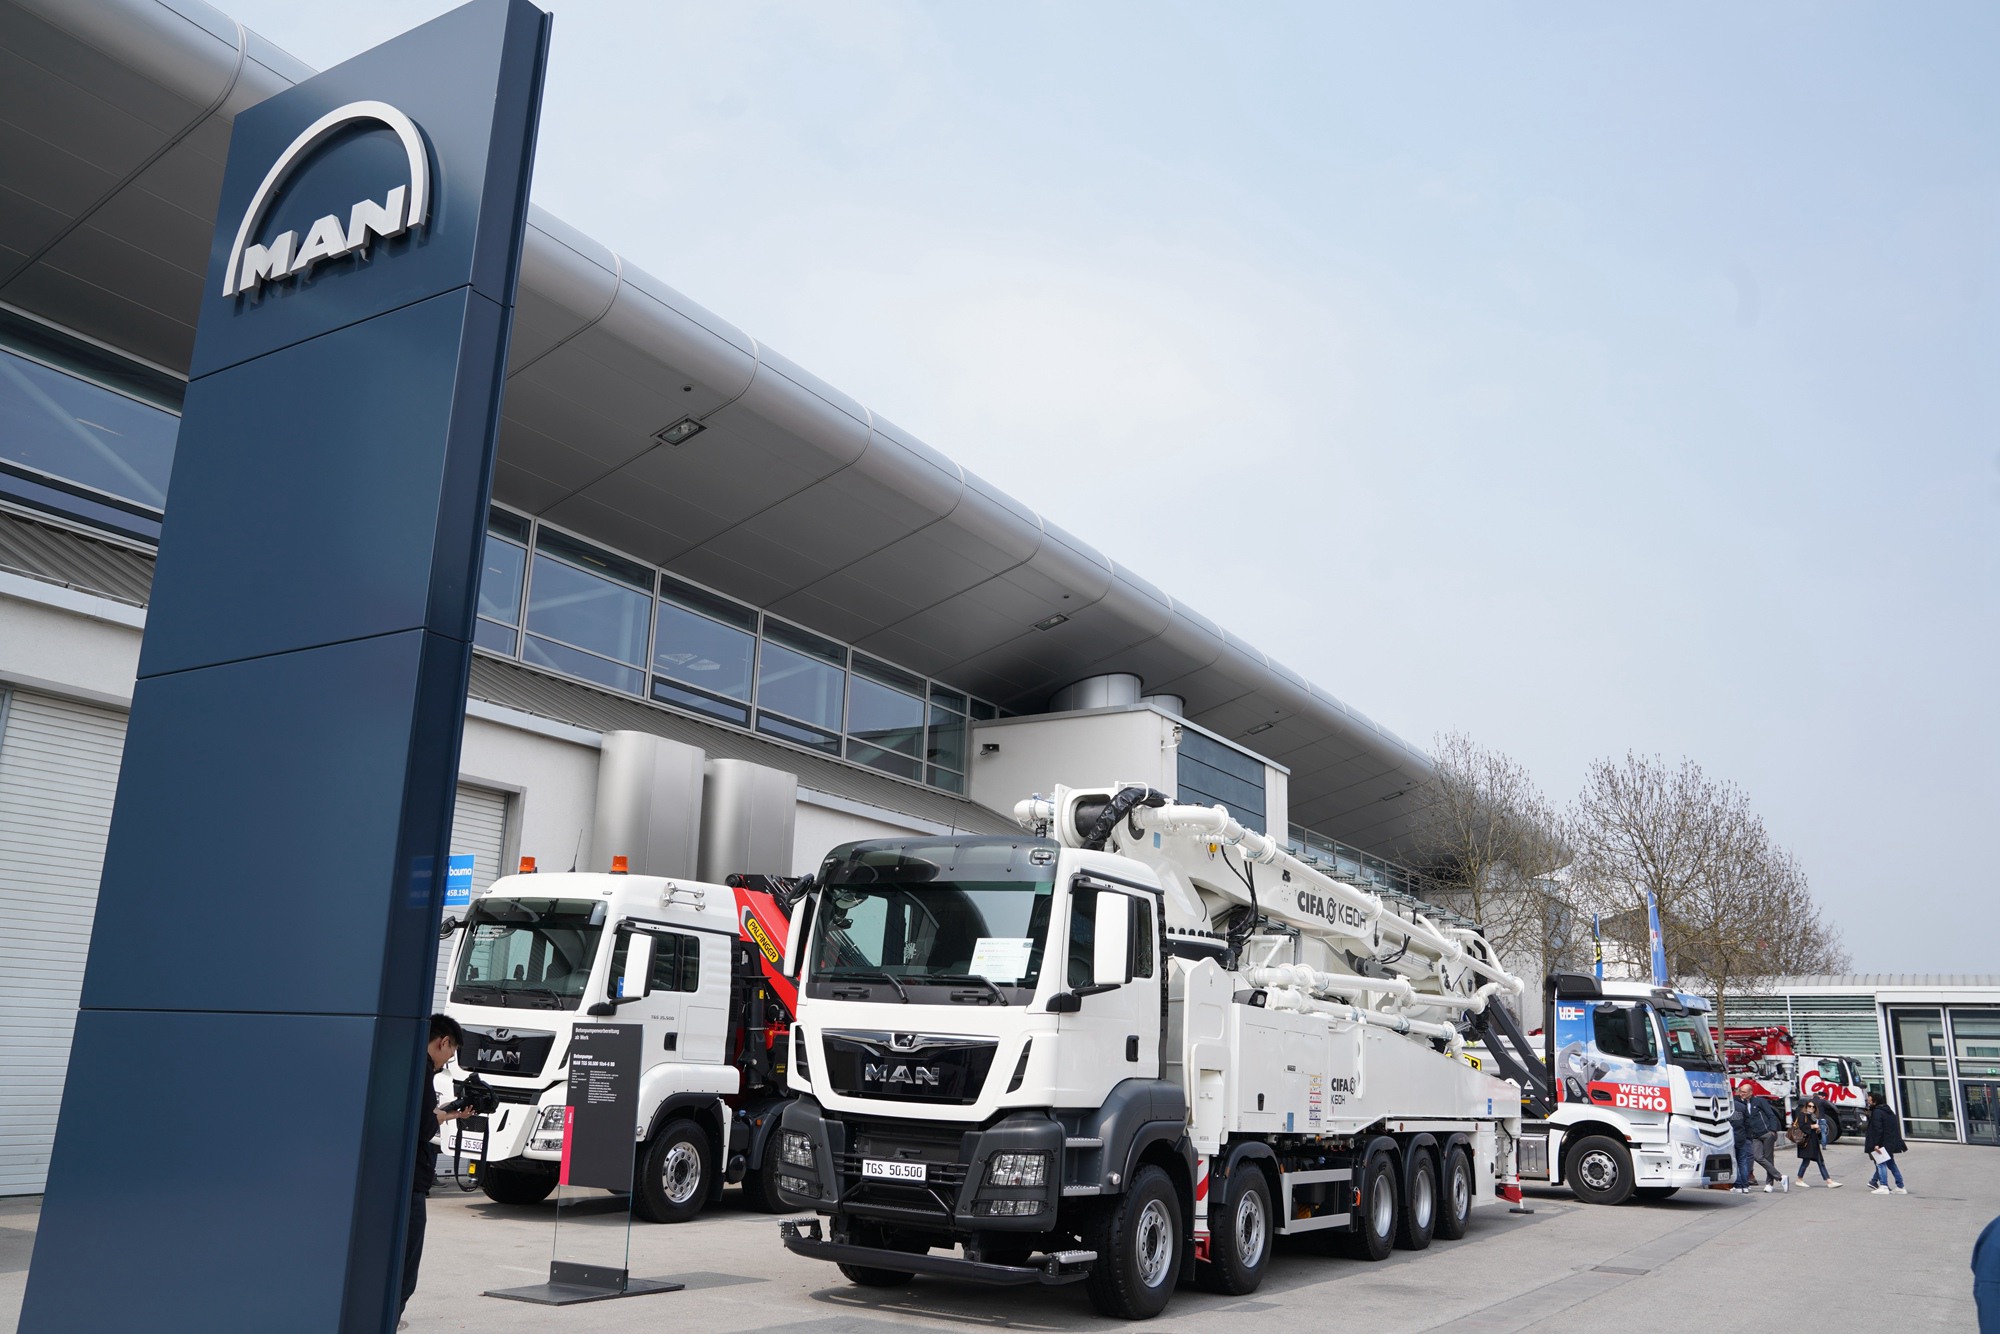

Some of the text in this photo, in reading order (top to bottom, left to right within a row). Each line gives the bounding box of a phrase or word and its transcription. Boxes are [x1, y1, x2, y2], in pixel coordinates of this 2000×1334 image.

[239, 183, 411, 293] MAN
[448, 865, 473, 877] bauma
[1297, 890, 1367, 930] CIFA K60H
[749, 921, 777, 960] PALFINGER
[1558, 1006, 1579, 1021] VDL
[477, 1048, 521, 1065] MAN
[864, 1063, 940, 1086] MAN
[1331, 1077, 1349, 1092] CIFA
[1618, 1083, 1661, 1097] WERKS
[1330, 1094, 1346, 1105] K60H
[1615, 1093, 1667, 1112] DEMO
[865, 1161, 923, 1178] TGS 50.500
